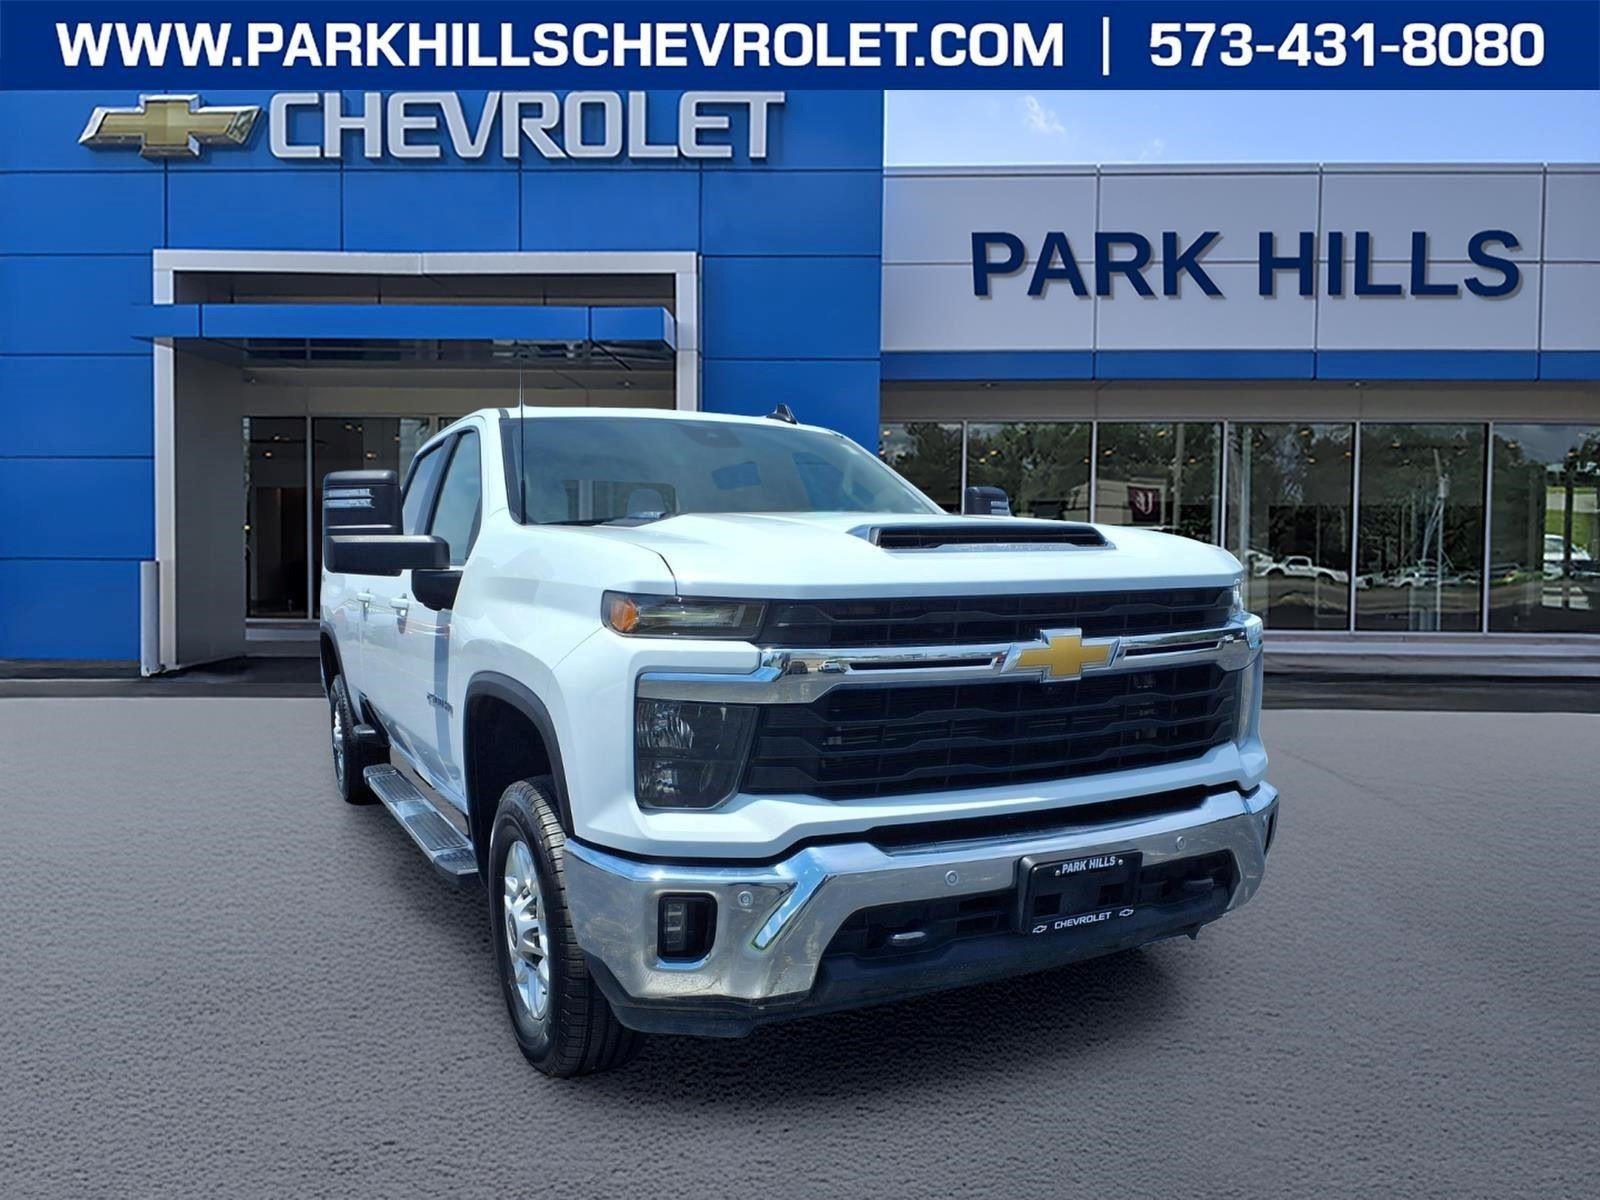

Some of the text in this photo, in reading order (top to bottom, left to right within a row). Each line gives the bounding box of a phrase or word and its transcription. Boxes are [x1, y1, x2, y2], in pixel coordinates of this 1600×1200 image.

[269, 90, 786, 160] CHEVROLET
[971, 229, 1523, 299] PARK HILLS
[1061, 856, 1116, 874] PARK HILLS
[1054, 911, 1112, 929] CHEVROLET
